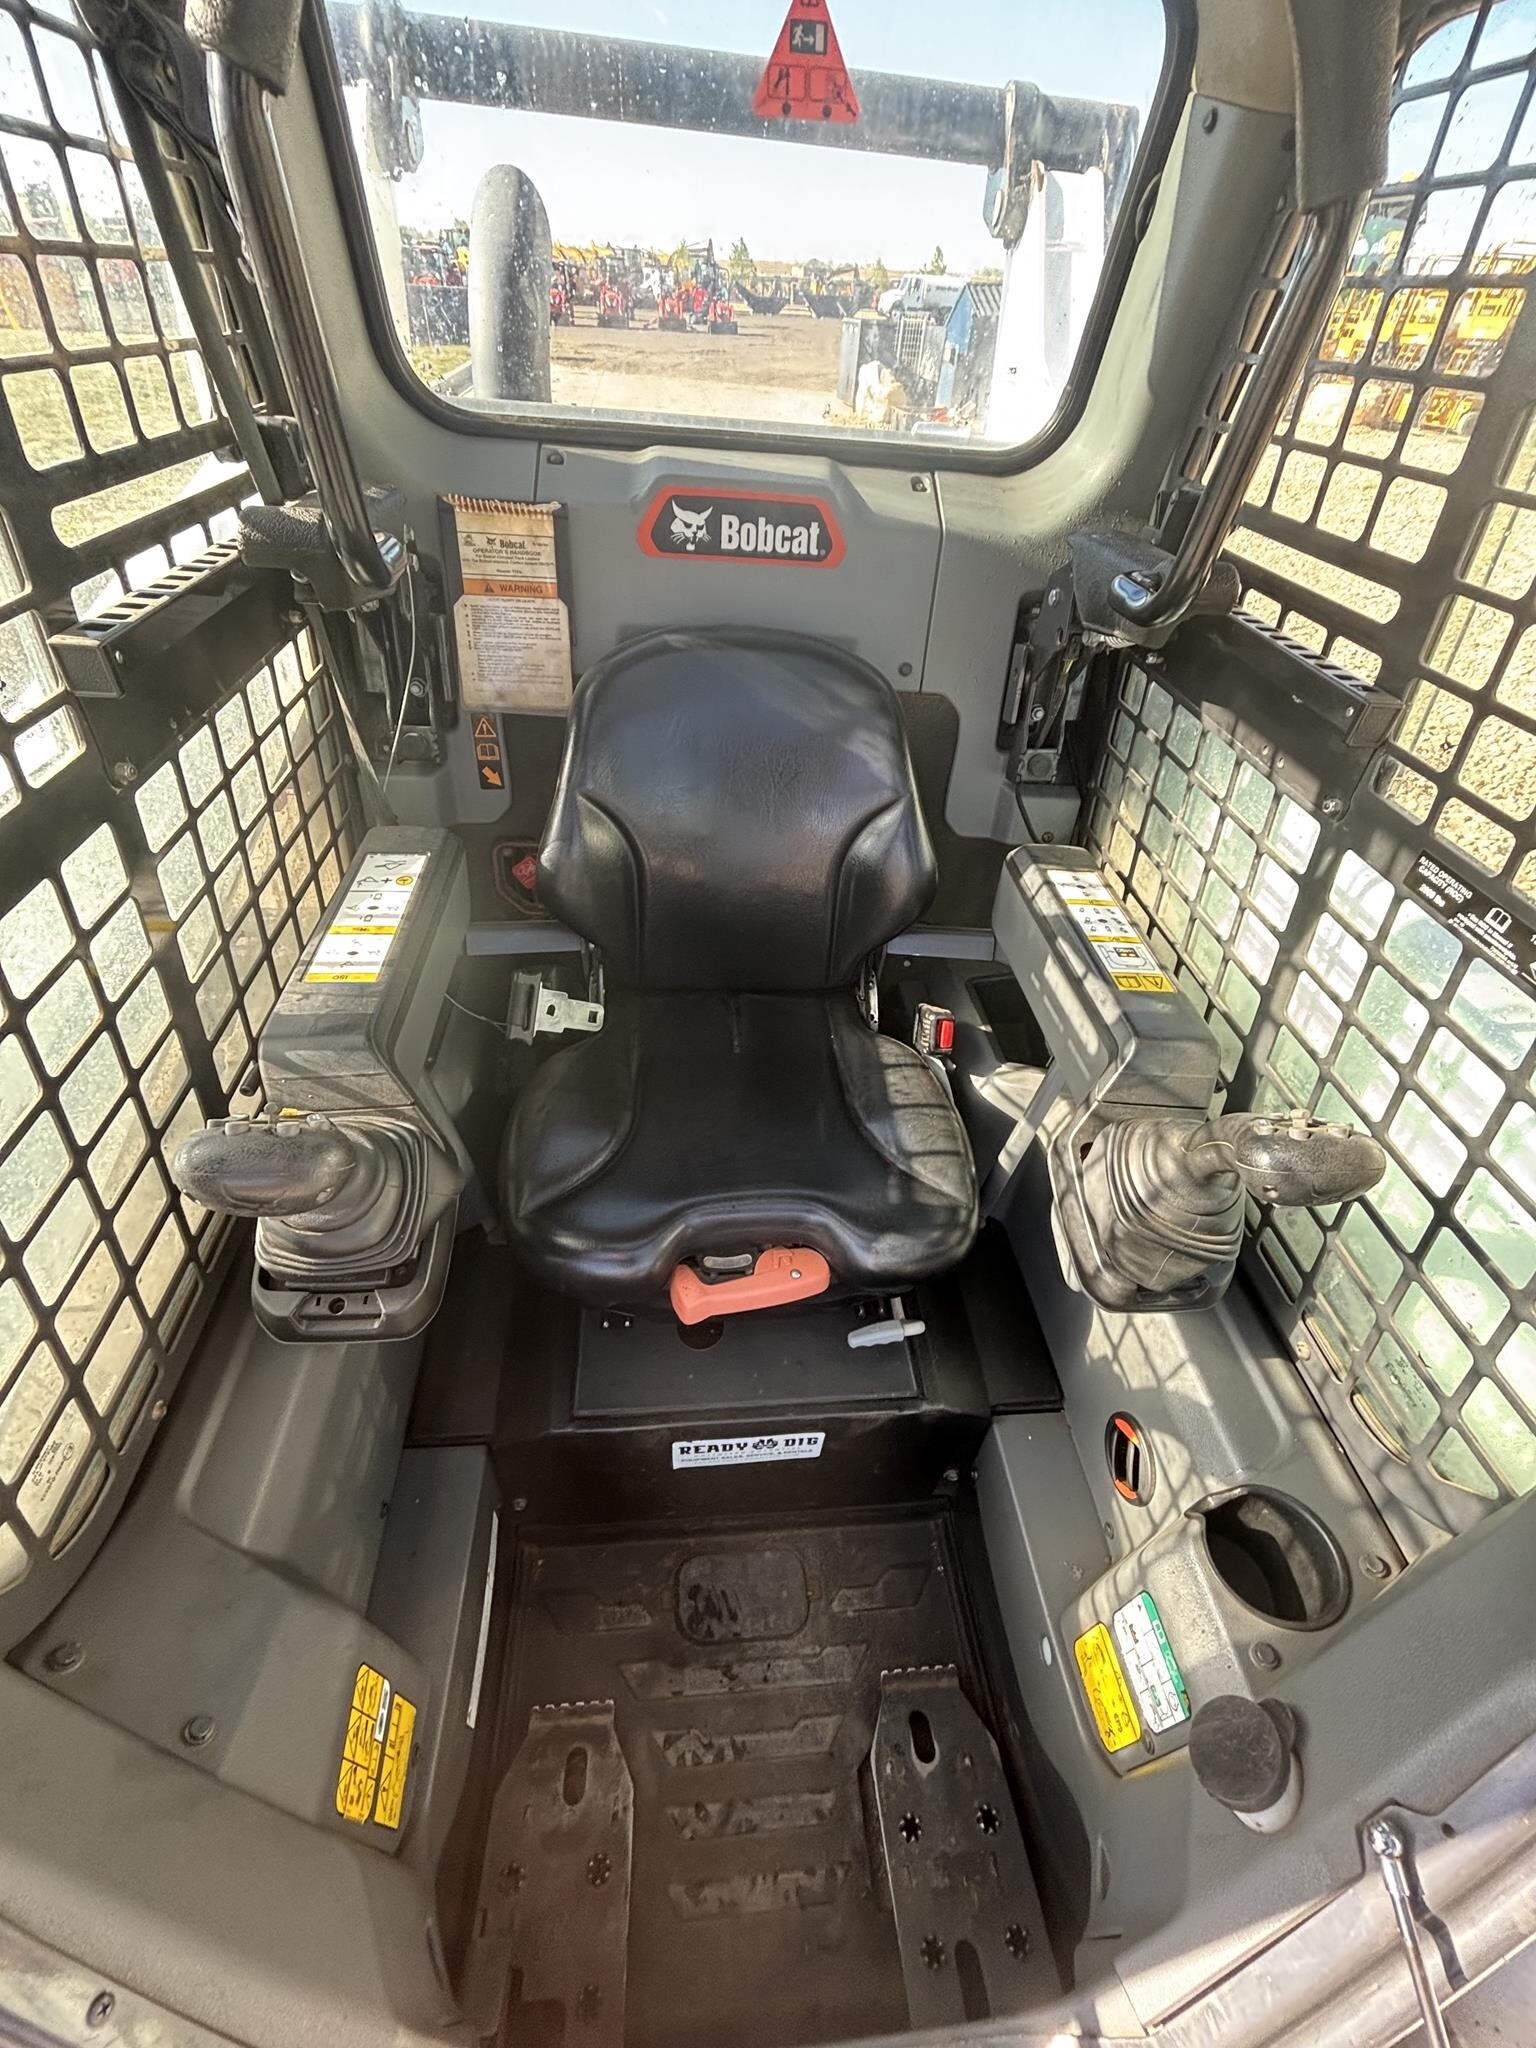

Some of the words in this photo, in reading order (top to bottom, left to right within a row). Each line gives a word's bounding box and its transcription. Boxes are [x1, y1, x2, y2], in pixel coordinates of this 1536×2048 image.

[499, 539, 526, 549] Bobcat
[721, 514, 820, 556] Bobcat
[499, 583, 543, 594] WARNING
[1418, 865, 1448, 889] CAPACITY
[1418, 856, 1440, 874] RATED
[1438, 870, 1473, 899] OPERATING
[678, 1442, 748, 1455] READY
[783, 1437, 819, 1447] DIG
